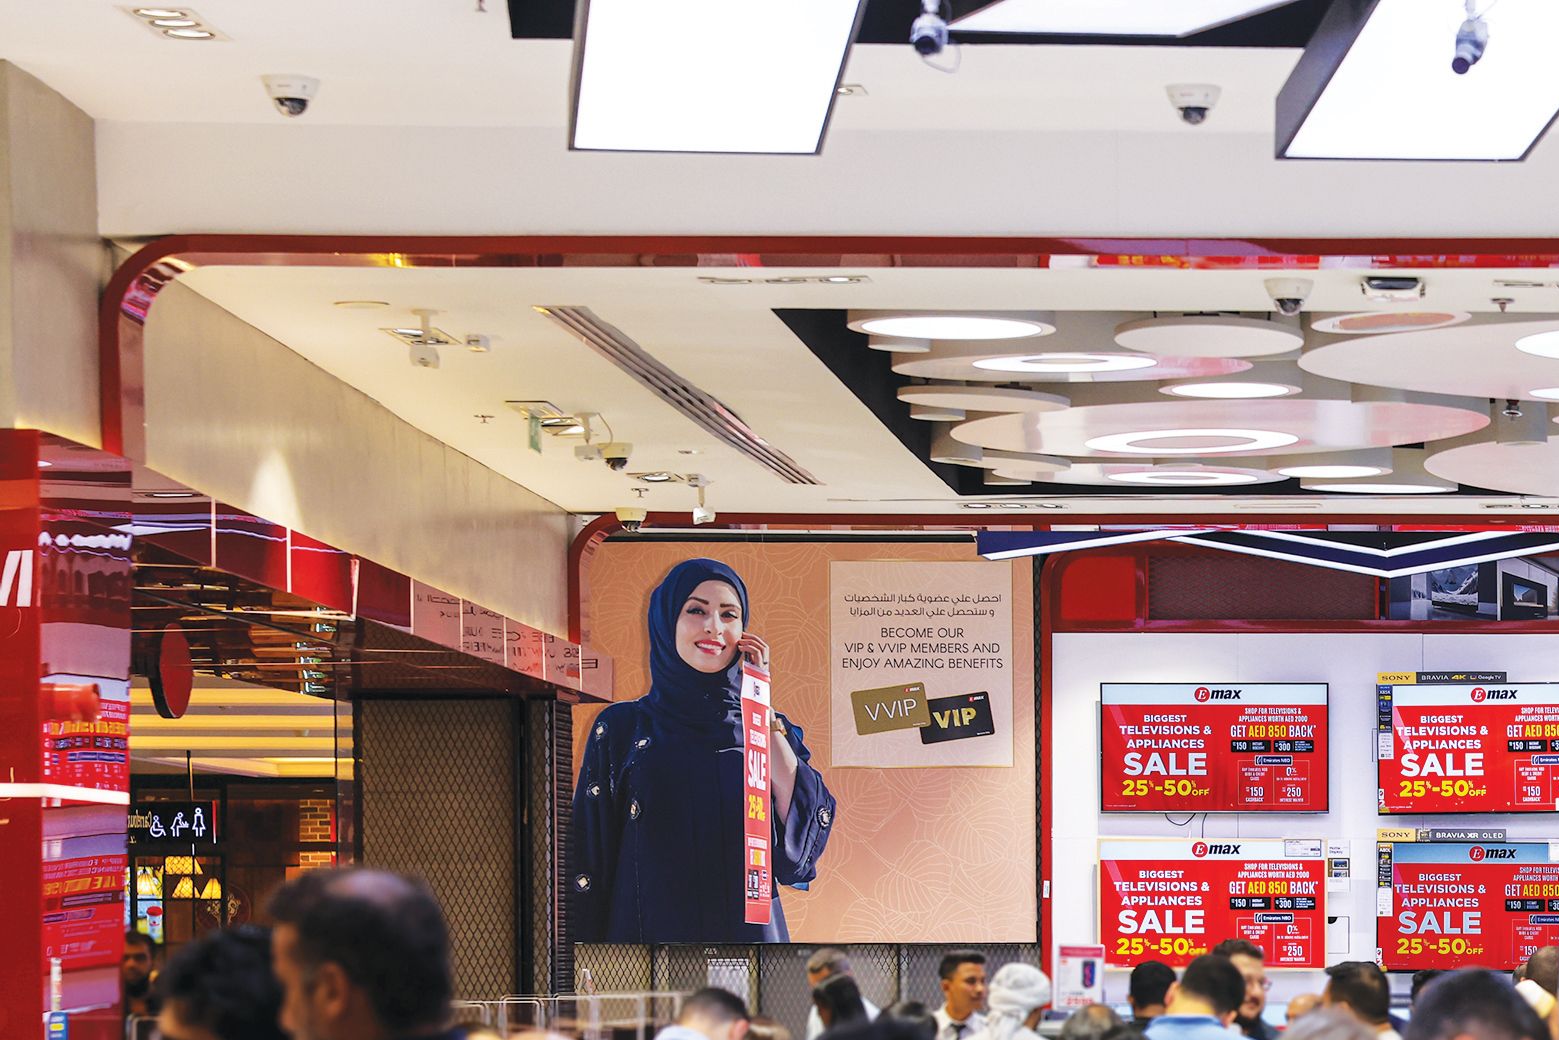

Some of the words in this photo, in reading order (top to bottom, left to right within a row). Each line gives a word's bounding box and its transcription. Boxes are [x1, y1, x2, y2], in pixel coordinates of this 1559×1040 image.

[880, 627, 933, 638] BECOME
[937, 627, 964, 638] OUR
[844, 643, 864, 653] VIP
[867, 643, 874, 653] &
[878, 643, 907, 653] VVIP
[910, 643, 969, 653] MEMBERS
[972, 643, 1000, 653] AND
[842, 658, 880, 670] ENJOY
[884, 658, 944, 669] AMAZING
[948, 658, 1003, 669] BENEFITS
[865, 698, 917, 721] VVIP
[932, 707, 976, 729] VIP
[1420, 715, 1463, 723] BIGGEST
[1120, 726, 1200, 734] TELEVISIONS
[1204, 726, 1212, 734] &
[1231, 725, 1246, 737] GET
[1249, 725, 1266, 737] AED
[1268, 725, 1286, 737] 850
[1396, 726, 1477, 736] TELEVISIONS
[1480, 726, 1488, 735] &
[1507, 725, 1523, 737] GET
[1525, 725, 1542, 737] AED
[1127, 740, 1204, 748] APPLIANCES
[1403, 740, 1481, 750] APPLIANCES
[748, 749, 766, 790] SALE
[1124, 752, 1207, 776] SALE
[1401, 753, 1484, 777] SALE
[1114, 882, 1198, 891] TELEVISIONS
[1201, 882, 1210, 891] &
[1229, 882, 1245, 894] GET
[1248, 882, 1266, 894] AED
[1269, 882, 1287, 894] 850
[1394, 885, 1475, 893] TELEVISIONS
[1478, 885, 1486, 893] &
[1505, 884, 1521, 896] GET
[1523, 885, 1540, 897] AED
[1543, 885, 1559, 897] 850
[1121, 896, 1202, 905] APPLIANCES
[1401, 898, 1479, 907] APPLIANCES
[1118, 910, 1205, 934] SALE
[1398, 911, 1481, 935] SALE
